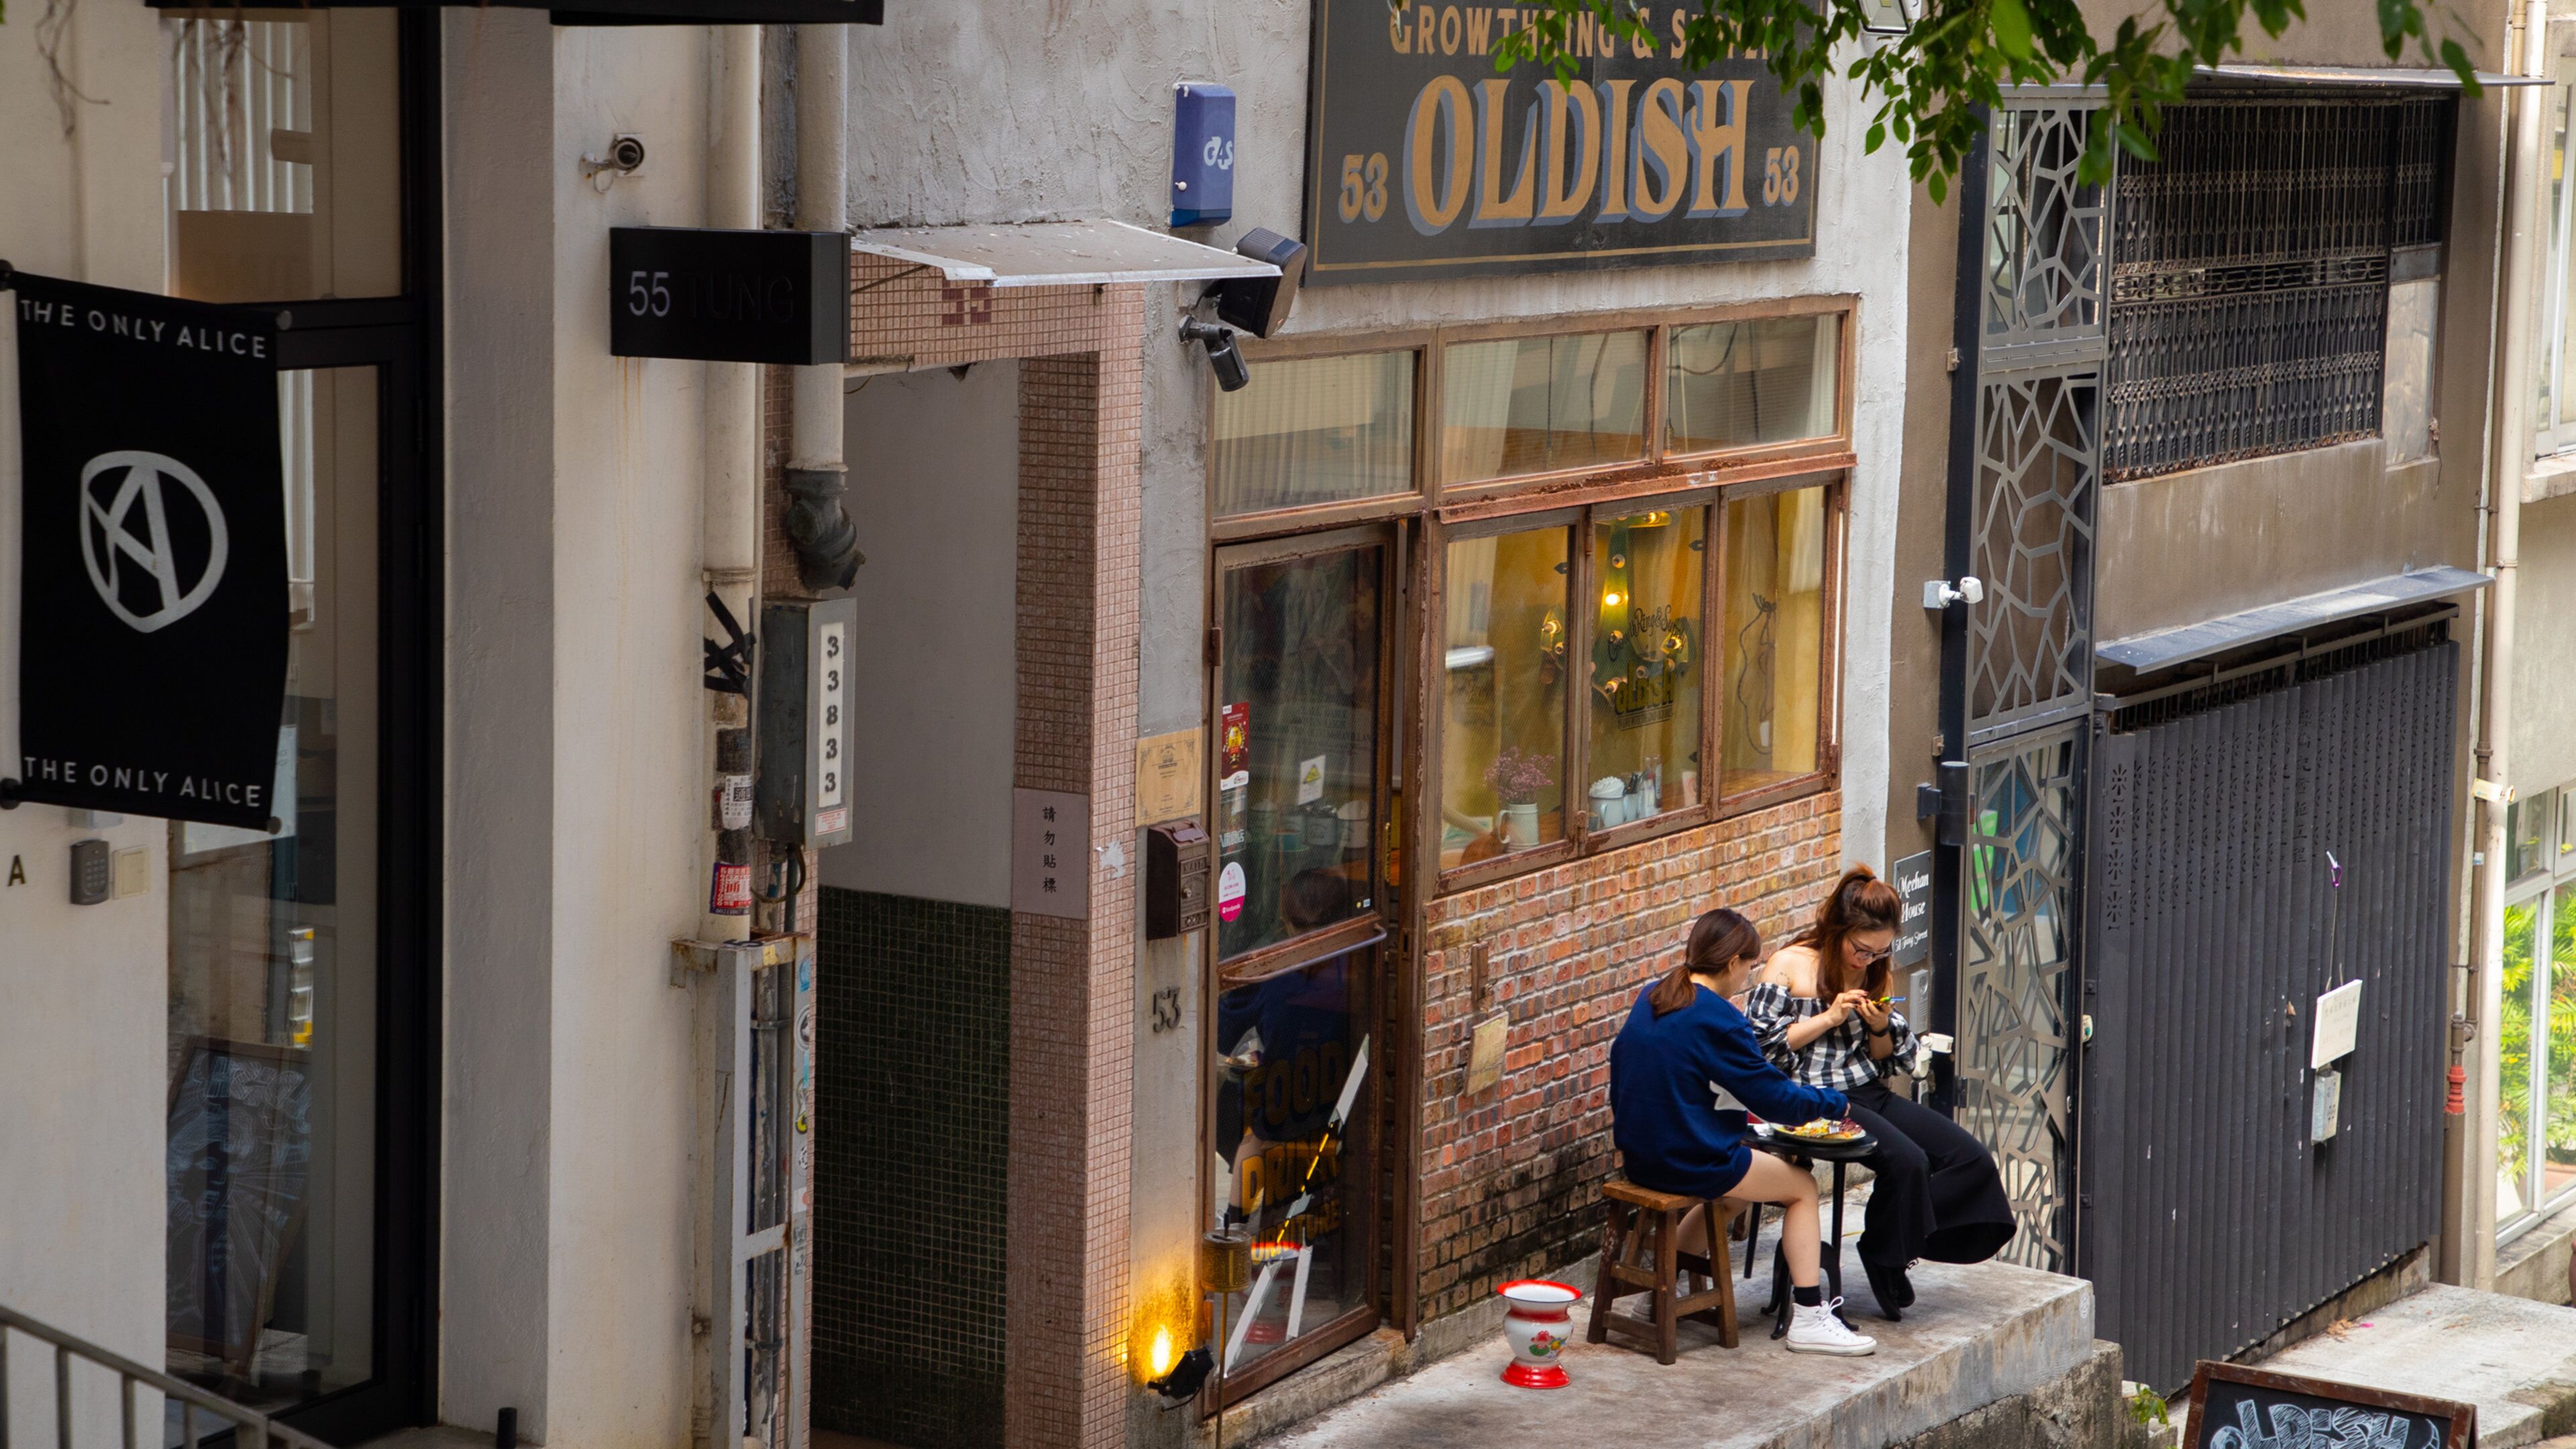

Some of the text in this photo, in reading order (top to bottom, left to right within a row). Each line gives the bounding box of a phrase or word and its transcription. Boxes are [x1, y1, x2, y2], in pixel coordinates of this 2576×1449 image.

[1389, 0, 1615, 58] GROWTHING
[1632, 7, 1654, 59] &
[1203, 136, 1234, 170] G4S
[1340, 74, 1801, 235] 53 OLDISH 53
[629, 270, 794, 323] 55 TUNG
[21, 299, 266, 358] THE ONLY ALICE
[824, 635, 840, 794] 33833
[24, 757, 262, 808] THE ONLY ALICE
[8, 855, 27, 887] A
[1042, 806, 1057, 894] 請勿貼標
[1900, 901, 1927, 924] House
[1152, 987, 1181, 1033] 53
[1243, 1040, 1342, 1134] FOOD
[1241, 1134, 1339, 1217] DRINK
[1250, 1197, 1340, 1265] URNITURE
